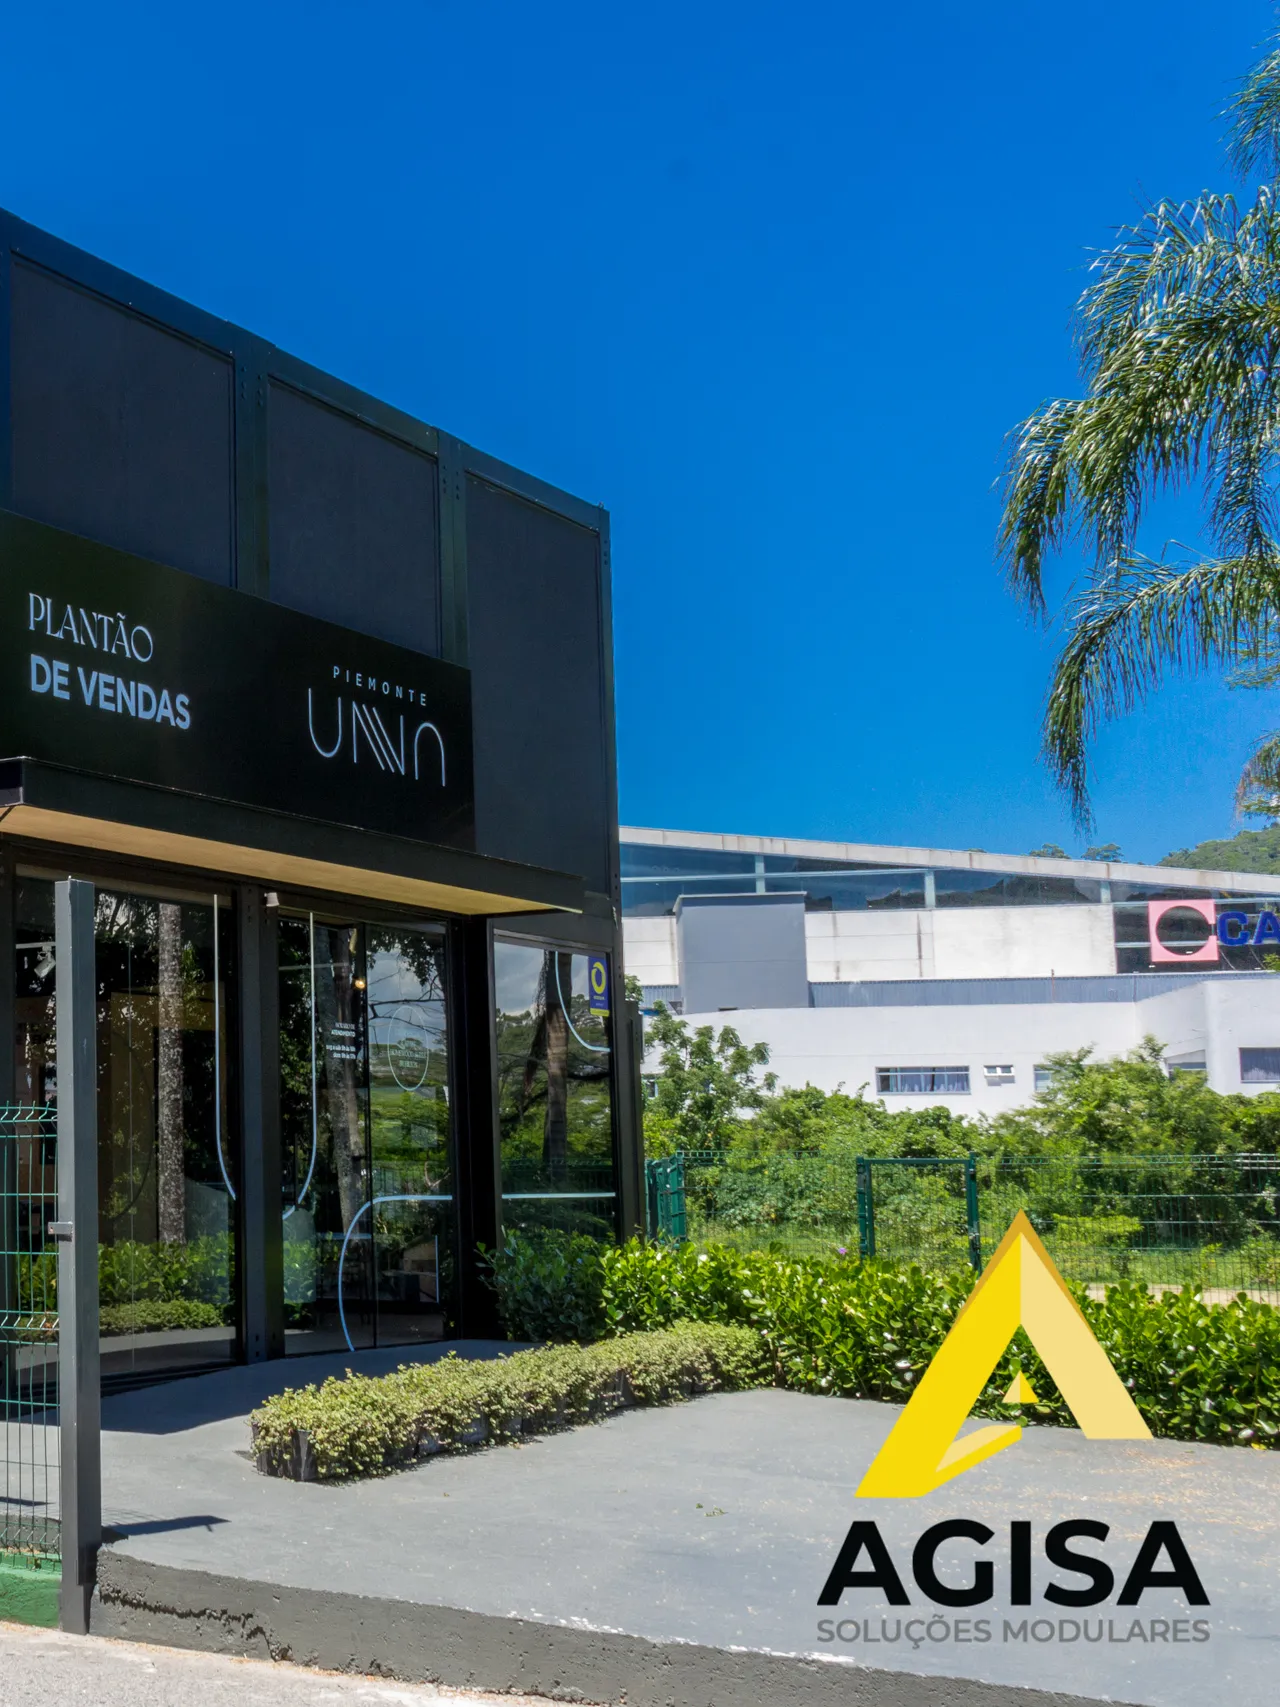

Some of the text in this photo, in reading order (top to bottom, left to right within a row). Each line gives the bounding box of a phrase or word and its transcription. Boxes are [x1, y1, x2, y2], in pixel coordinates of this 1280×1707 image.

[27, 592, 154, 663] PLANTÃO
[30, 653, 191, 730] DE VENDAS
[332, 665, 428, 707] PIEMONTE
